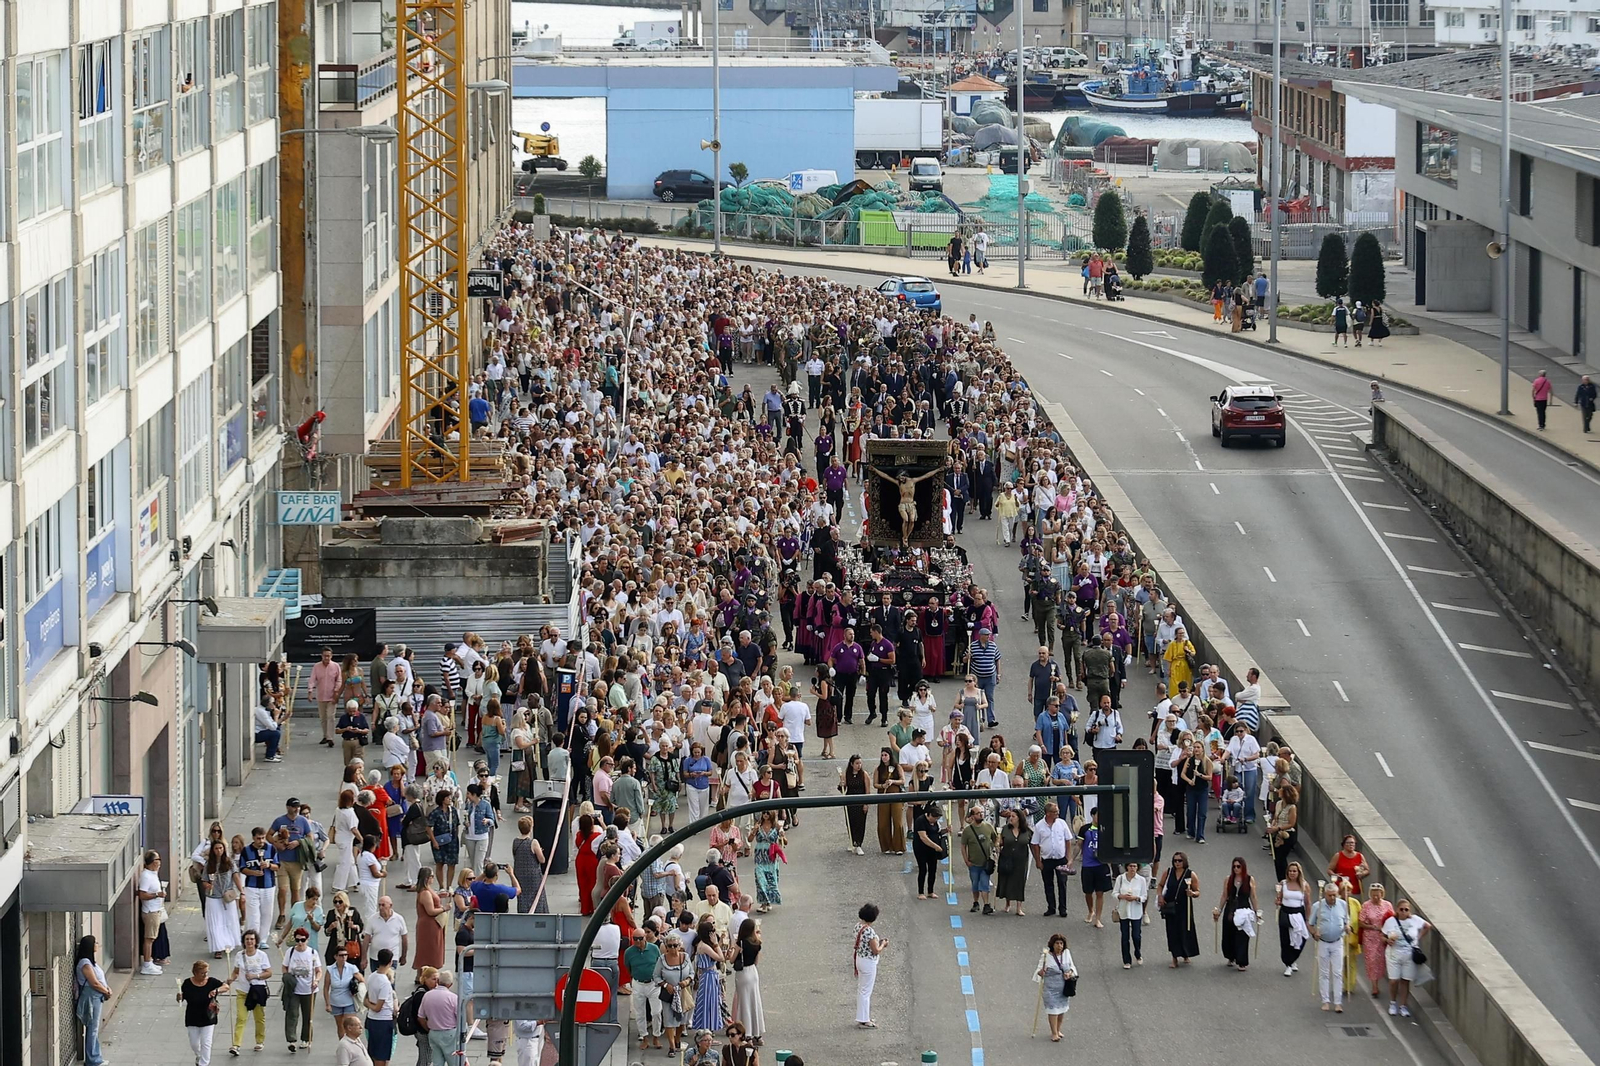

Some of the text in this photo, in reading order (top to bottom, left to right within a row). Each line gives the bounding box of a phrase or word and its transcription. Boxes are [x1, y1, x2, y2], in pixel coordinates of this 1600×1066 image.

[281, 492, 336, 504] CAFÉ BAR
[282, 506, 335, 522] LIÑA
[319, 616, 354, 625] mobalco
